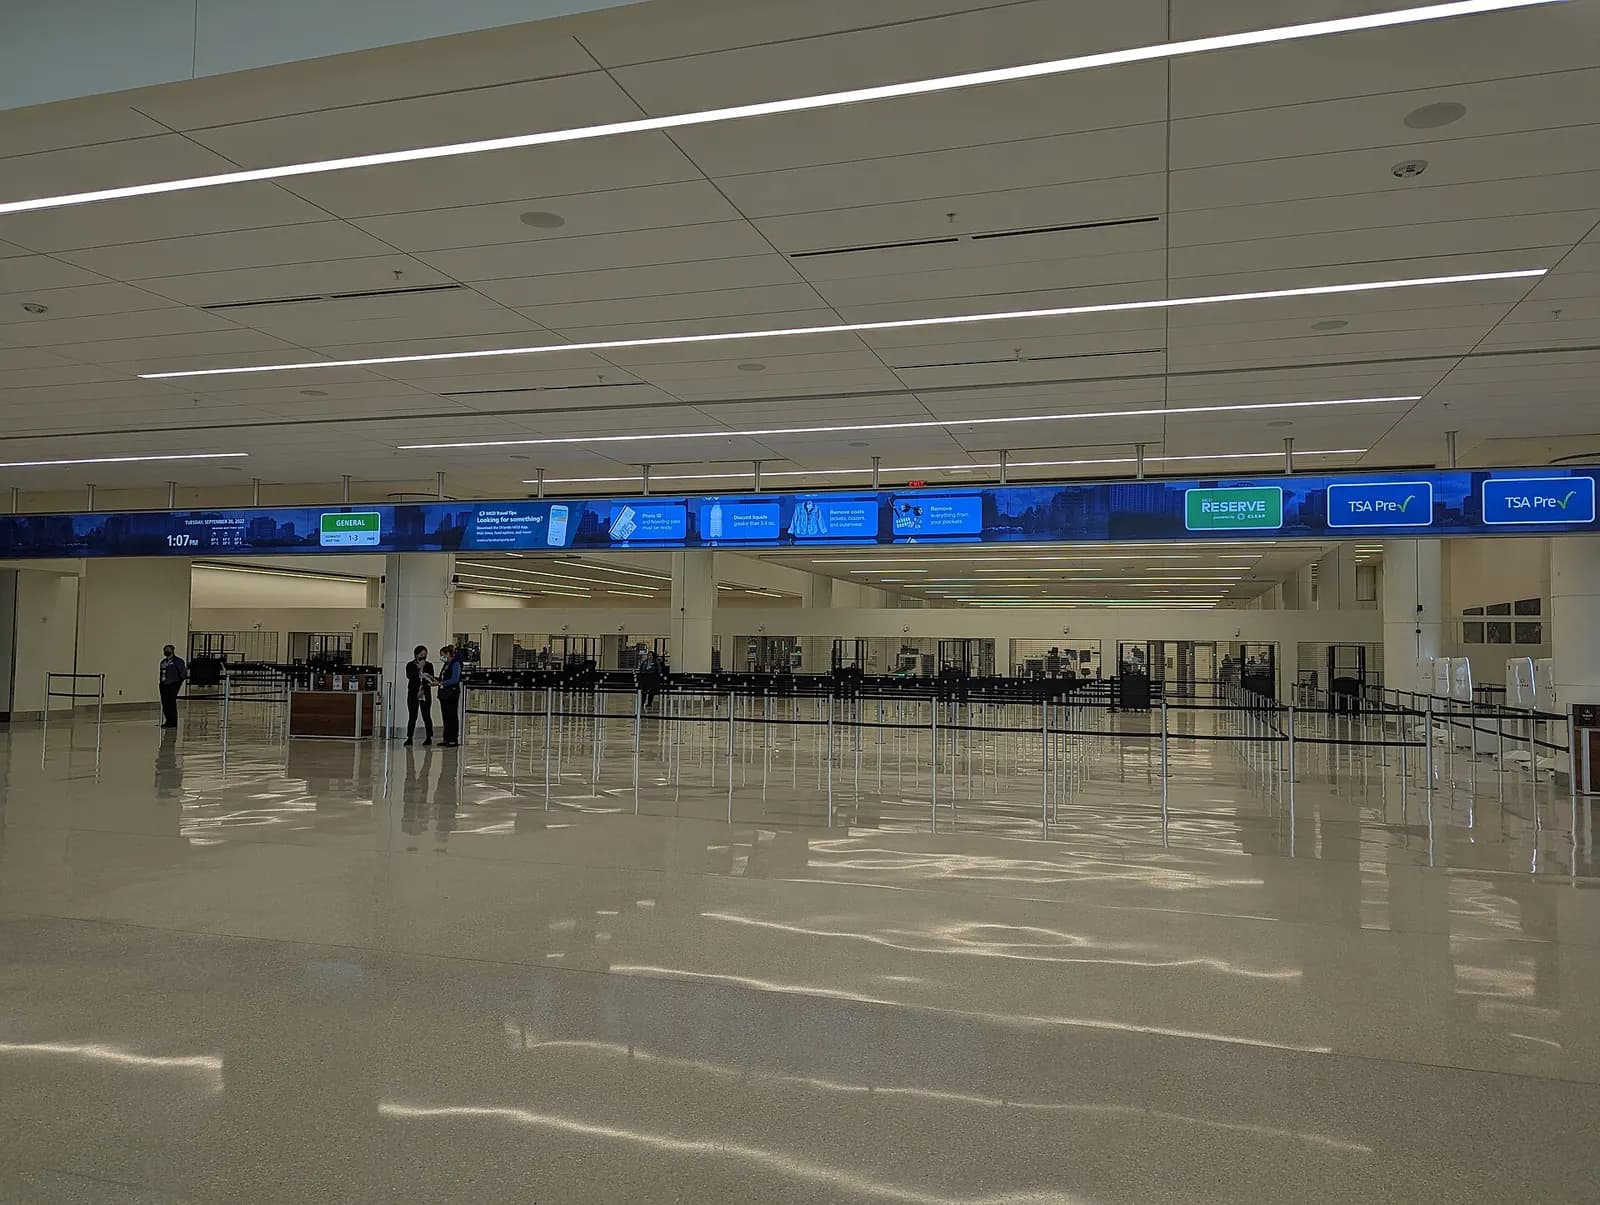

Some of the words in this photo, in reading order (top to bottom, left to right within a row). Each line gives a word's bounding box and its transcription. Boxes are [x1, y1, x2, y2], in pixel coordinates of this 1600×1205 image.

[1202, 501, 1265, 512] RESERVE
[1348, 500, 1372, 512] TSA
[1505, 496, 1530, 508] TSA
[167, 535, 189, 546] 1:07
